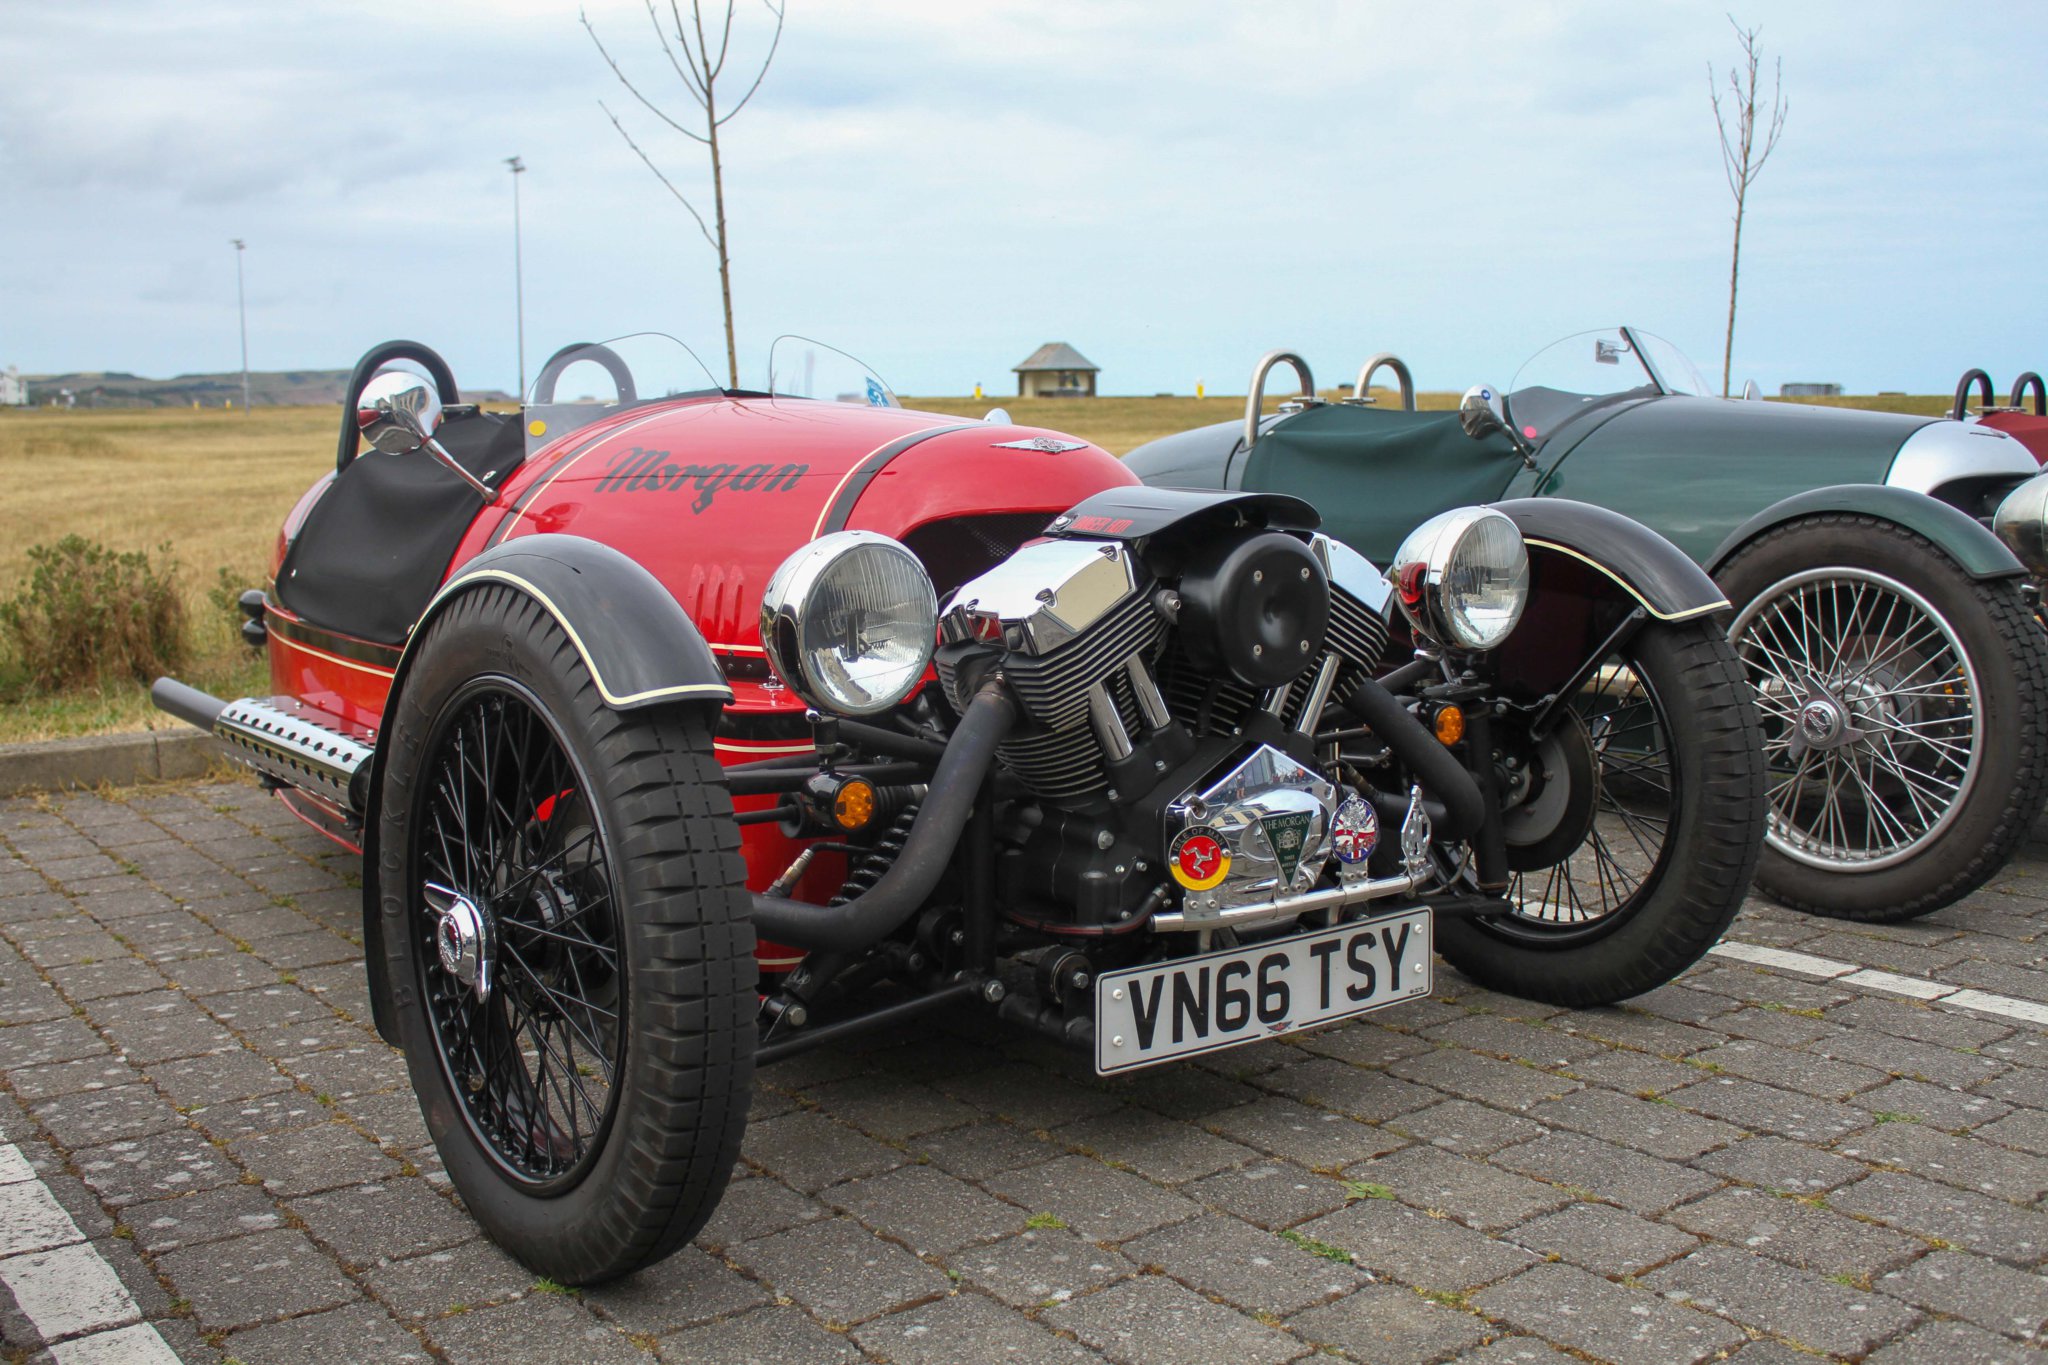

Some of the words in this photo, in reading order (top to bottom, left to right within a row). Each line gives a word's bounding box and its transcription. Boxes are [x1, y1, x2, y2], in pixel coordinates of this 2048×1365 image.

[593, 446, 810, 516] Morgan
[1172, 832, 1190, 852] ISLE
[1207, 829, 1225, 846] MAN
[1263, 819, 1278, 830] THE
[1278, 814, 1310, 828] MORGAN
[1128, 952, 1290, 1051] VN66
[1310, 922, 1411, 1010] TSY
